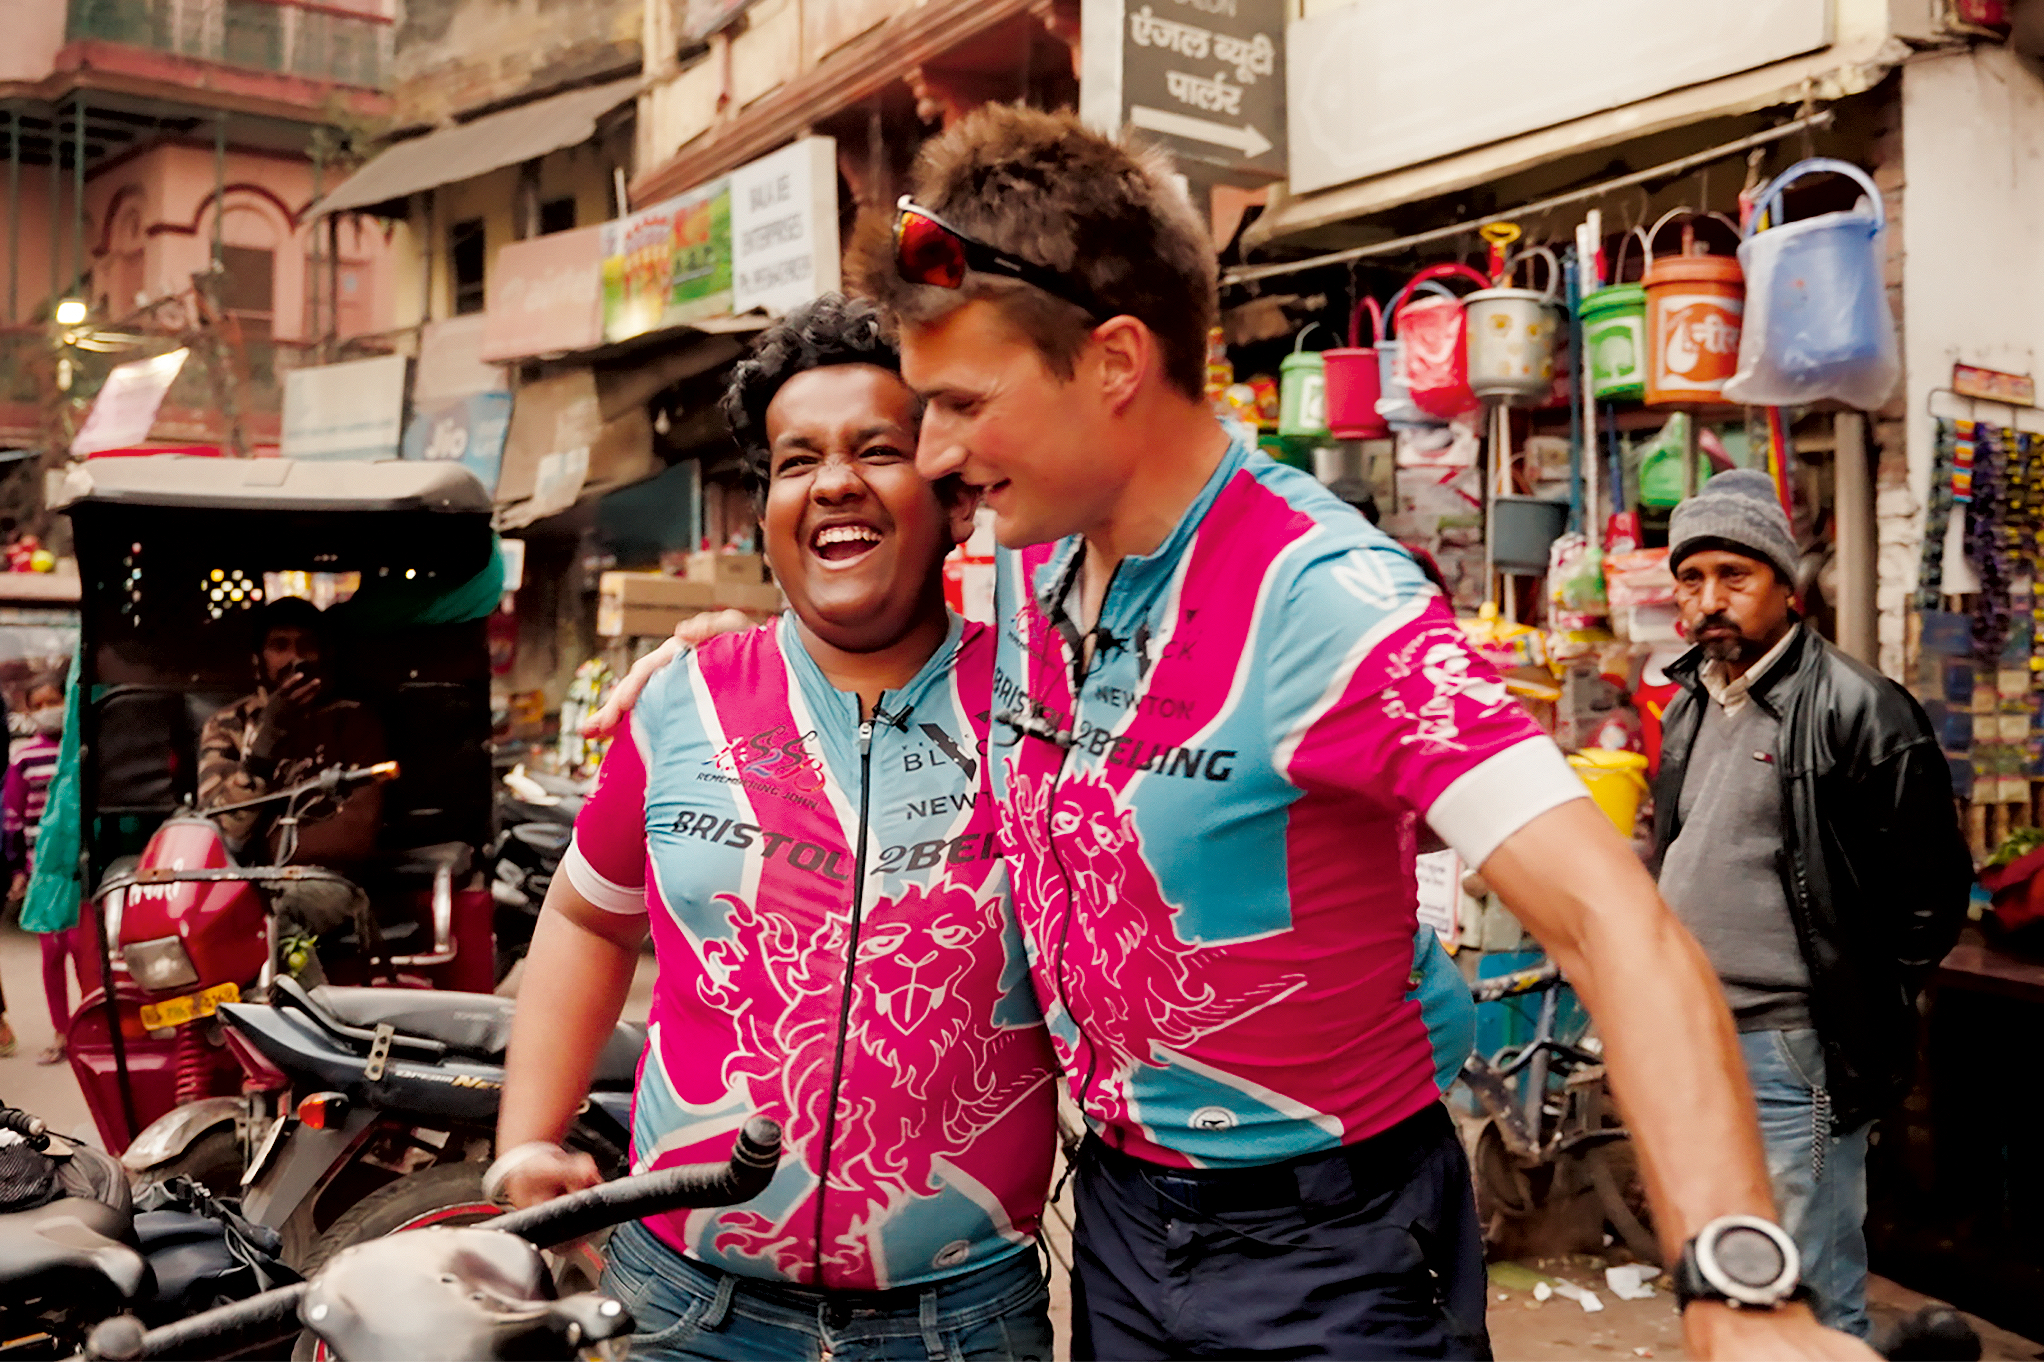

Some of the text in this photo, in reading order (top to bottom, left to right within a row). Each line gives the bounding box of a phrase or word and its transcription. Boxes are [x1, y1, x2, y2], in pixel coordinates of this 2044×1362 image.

[424, 418, 468, 459] Jio
[1074, 721, 1237, 781] 2BEIJING
[696, 772, 780, 796] REMEMBERING
[672, 810, 850, 881] BRISTOL
